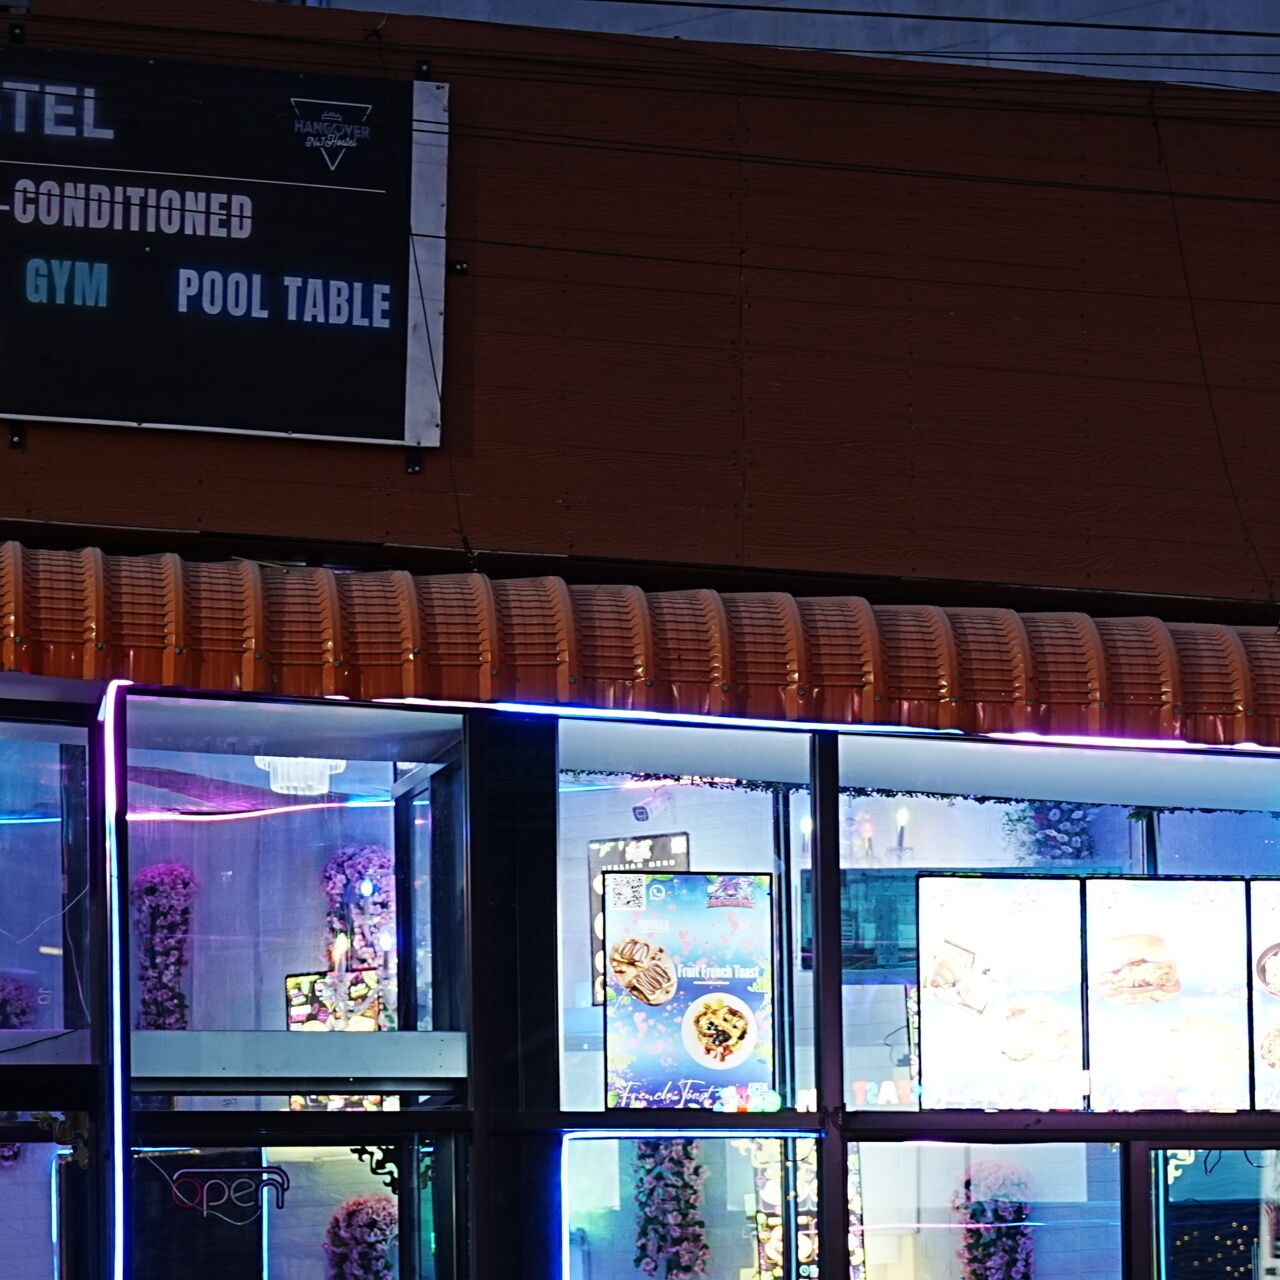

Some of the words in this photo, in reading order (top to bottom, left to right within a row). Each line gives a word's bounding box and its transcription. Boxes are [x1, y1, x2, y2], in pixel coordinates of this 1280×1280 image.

[294, 119, 370, 139] HANGOVER
[25, 259, 108, 308] GYM
[177, 267, 269, 321] POOL
[283, 275, 392, 330] TABLE
[677, 964, 701, 979] Fruit
[701, 965, 733, 980] French
[734, 965, 760, 979] Toast
[171, 1177, 286, 1218] open
